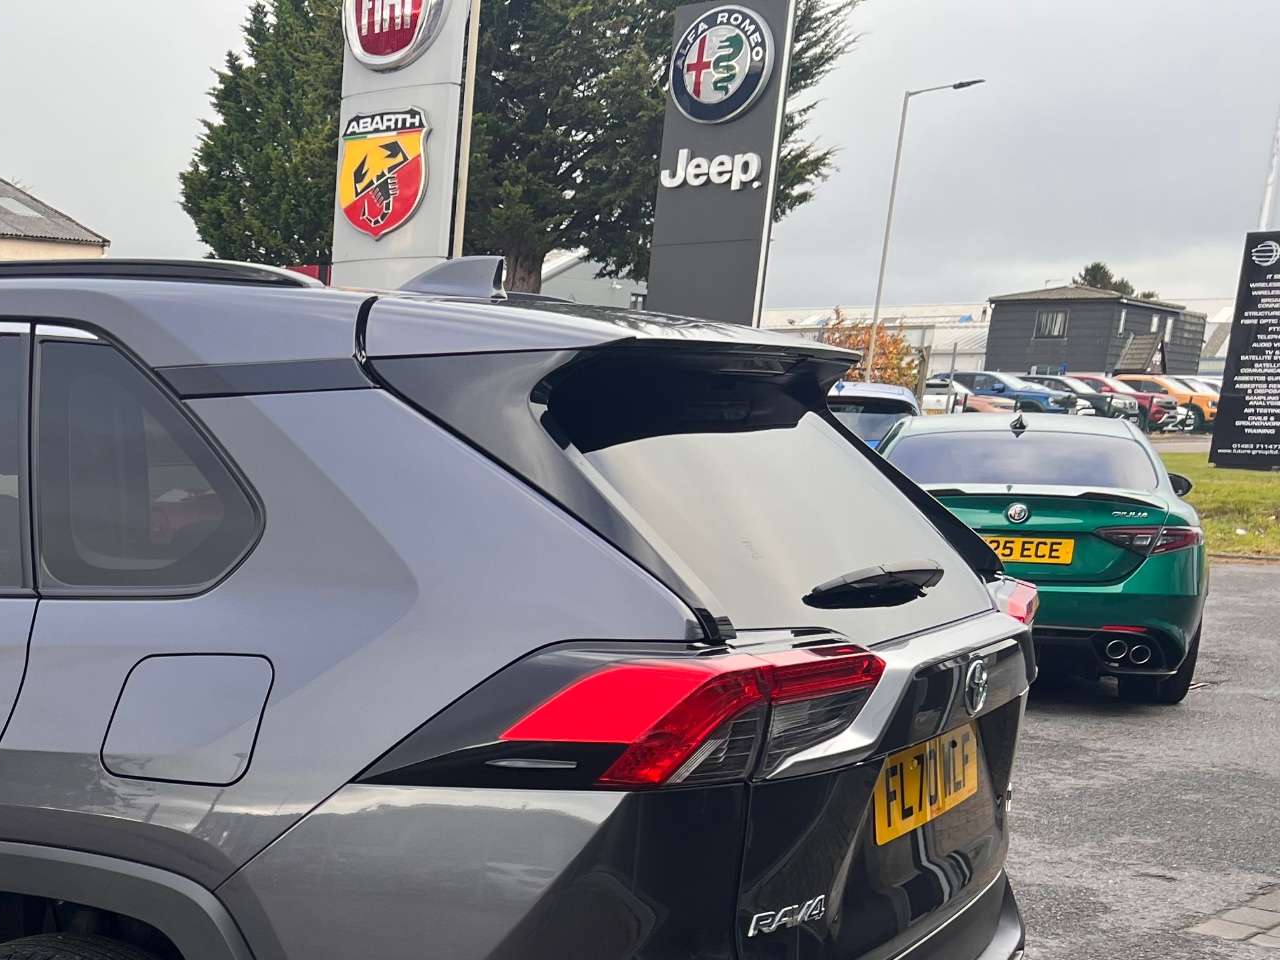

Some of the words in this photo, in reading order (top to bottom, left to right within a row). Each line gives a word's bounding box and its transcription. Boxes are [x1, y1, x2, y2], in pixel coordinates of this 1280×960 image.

[717, 12, 763, 62] ROMEO
[346, 114, 421, 135] ABARTH
[1020, 541, 1063, 560] ECE
[747, 894, 825, 937] RAV4
